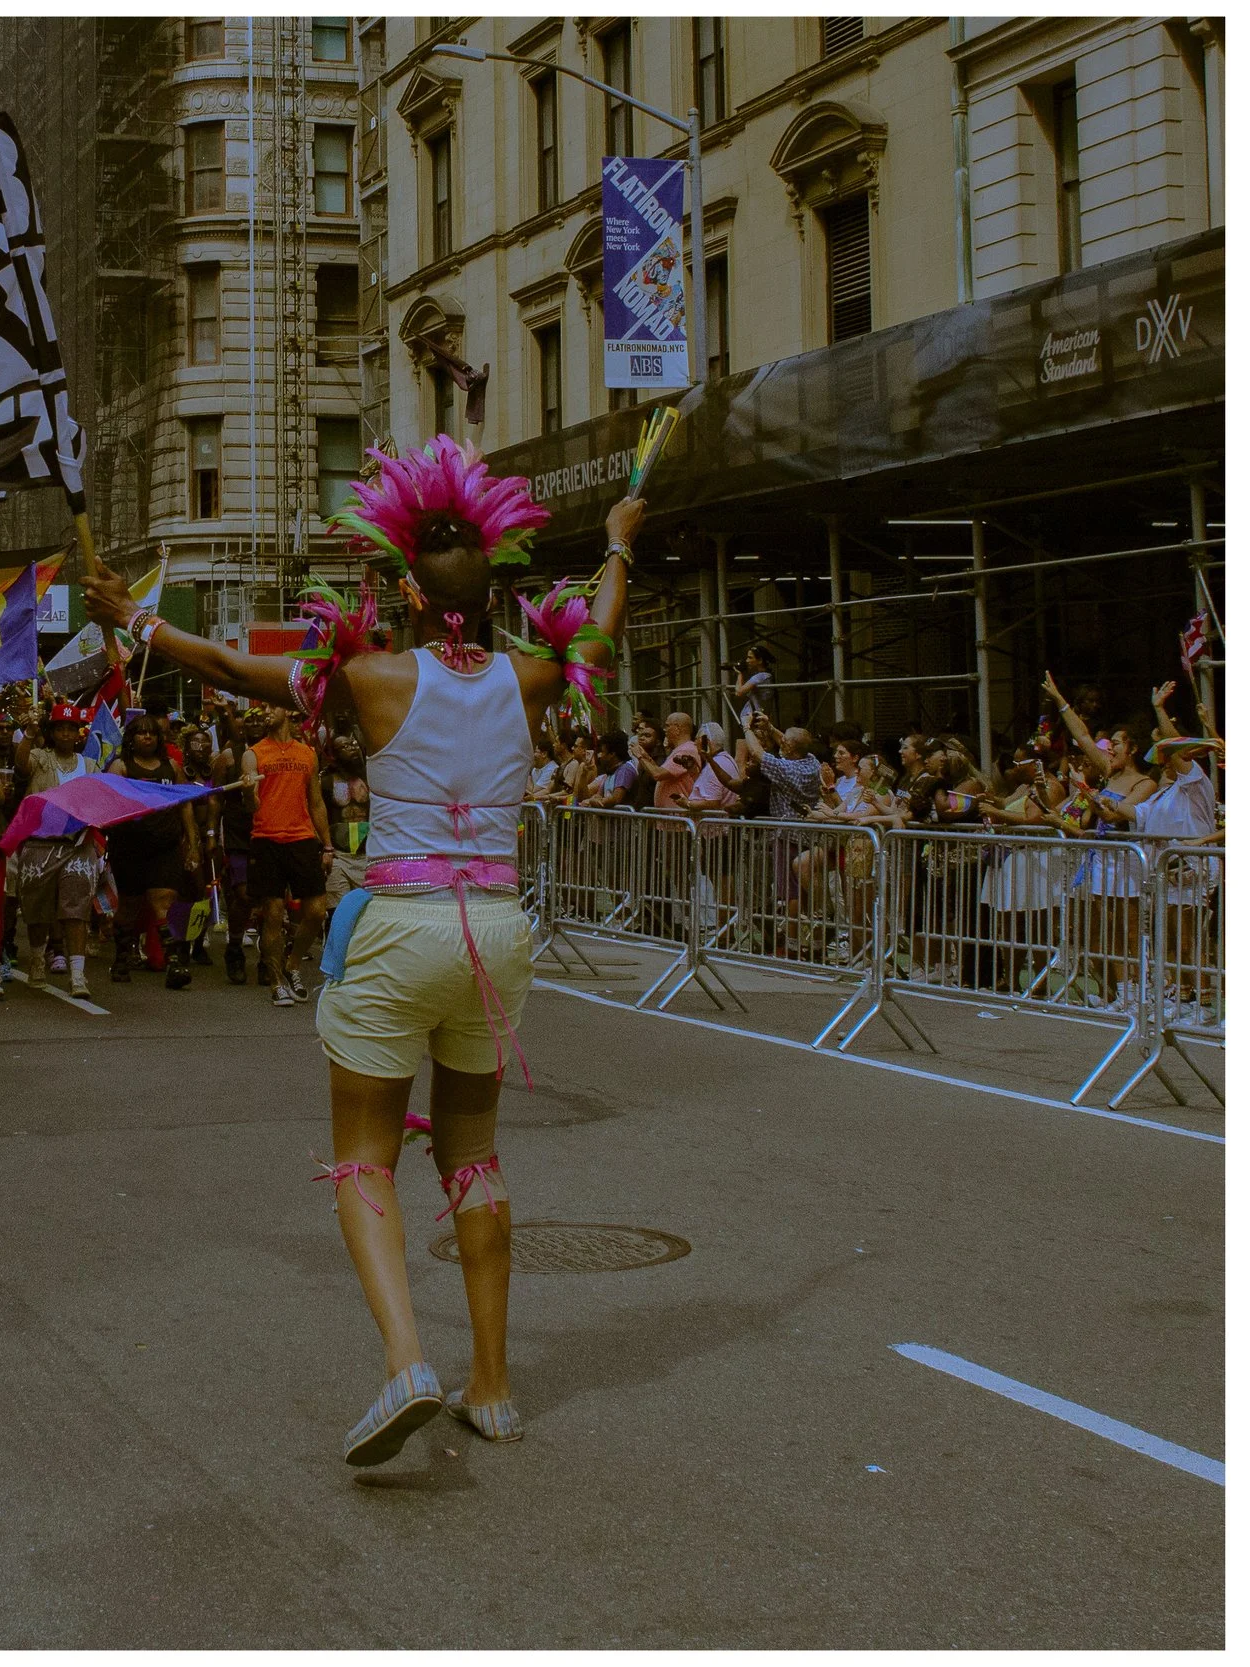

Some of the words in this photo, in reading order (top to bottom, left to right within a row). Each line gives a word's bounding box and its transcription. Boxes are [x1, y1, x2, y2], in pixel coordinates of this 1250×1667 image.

[602, 156, 680, 236] FLATIRON
[606, 217, 630, 226] Where
[606, 226, 622, 234] New
[623, 226, 641, 235] York
[606, 243, 622, 251] New
[623, 243, 641, 252] York
[612, 276, 675, 340] NOMAD
[1039, 328, 1101, 360] American
[1135, 293, 1194, 364] DXV
[607, 343, 685, 354] FLATIRONNOMAD.NYC
[630, 356, 663, 376] ABS
[1040, 347, 1097, 384] Standard
[534, 457, 606, 501] EXPERIENCE
